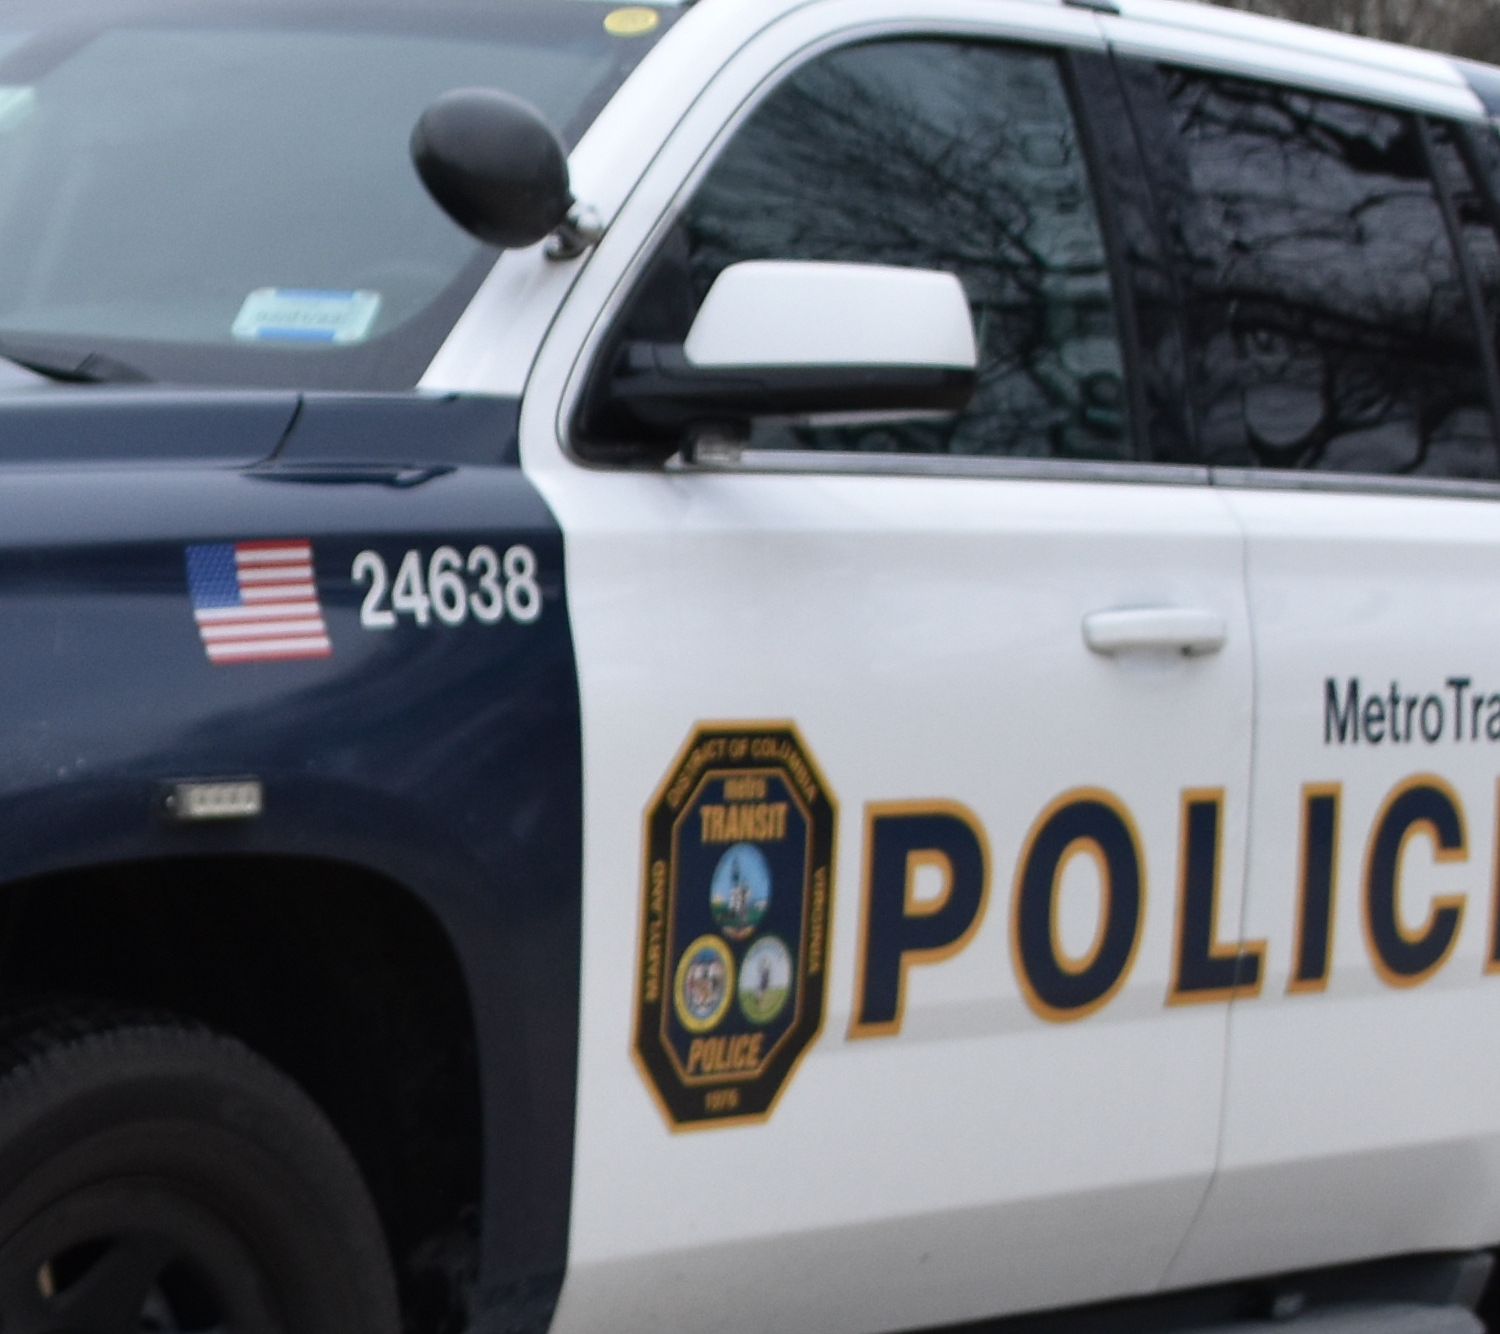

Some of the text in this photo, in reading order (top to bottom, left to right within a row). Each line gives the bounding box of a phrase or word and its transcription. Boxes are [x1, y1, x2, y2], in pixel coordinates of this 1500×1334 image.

[351, 544, 543, 629] 24638
[729, 737, 750, 759] OF
[701, 801, 788, 843] TRANSIT
[644, 859, 667, 1003] MARYLAND
[687, 1032, 765, 1075] POLICE
